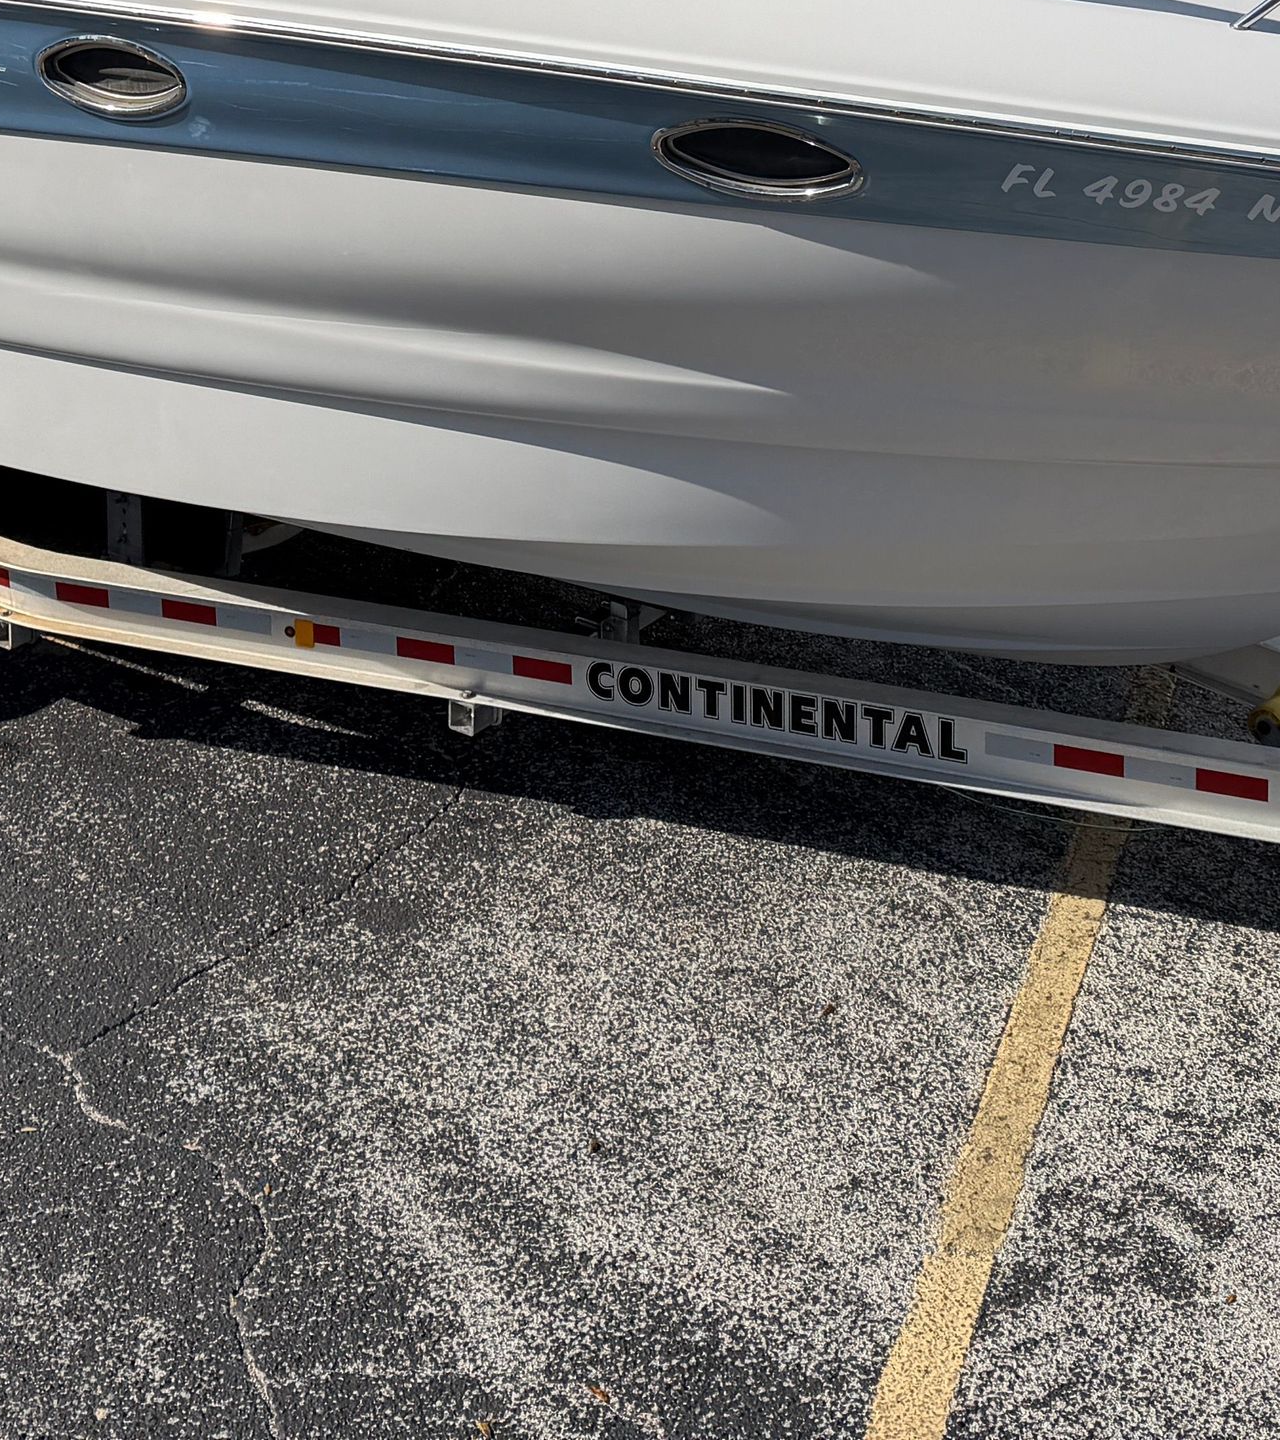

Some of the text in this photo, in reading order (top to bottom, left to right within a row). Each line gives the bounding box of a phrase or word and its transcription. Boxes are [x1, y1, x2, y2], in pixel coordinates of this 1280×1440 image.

[1000, 162, 1057, 199] FL
[1082, 174, 1222, 216] 4984
[585, 660, 969, 765] CONTINENTAL
